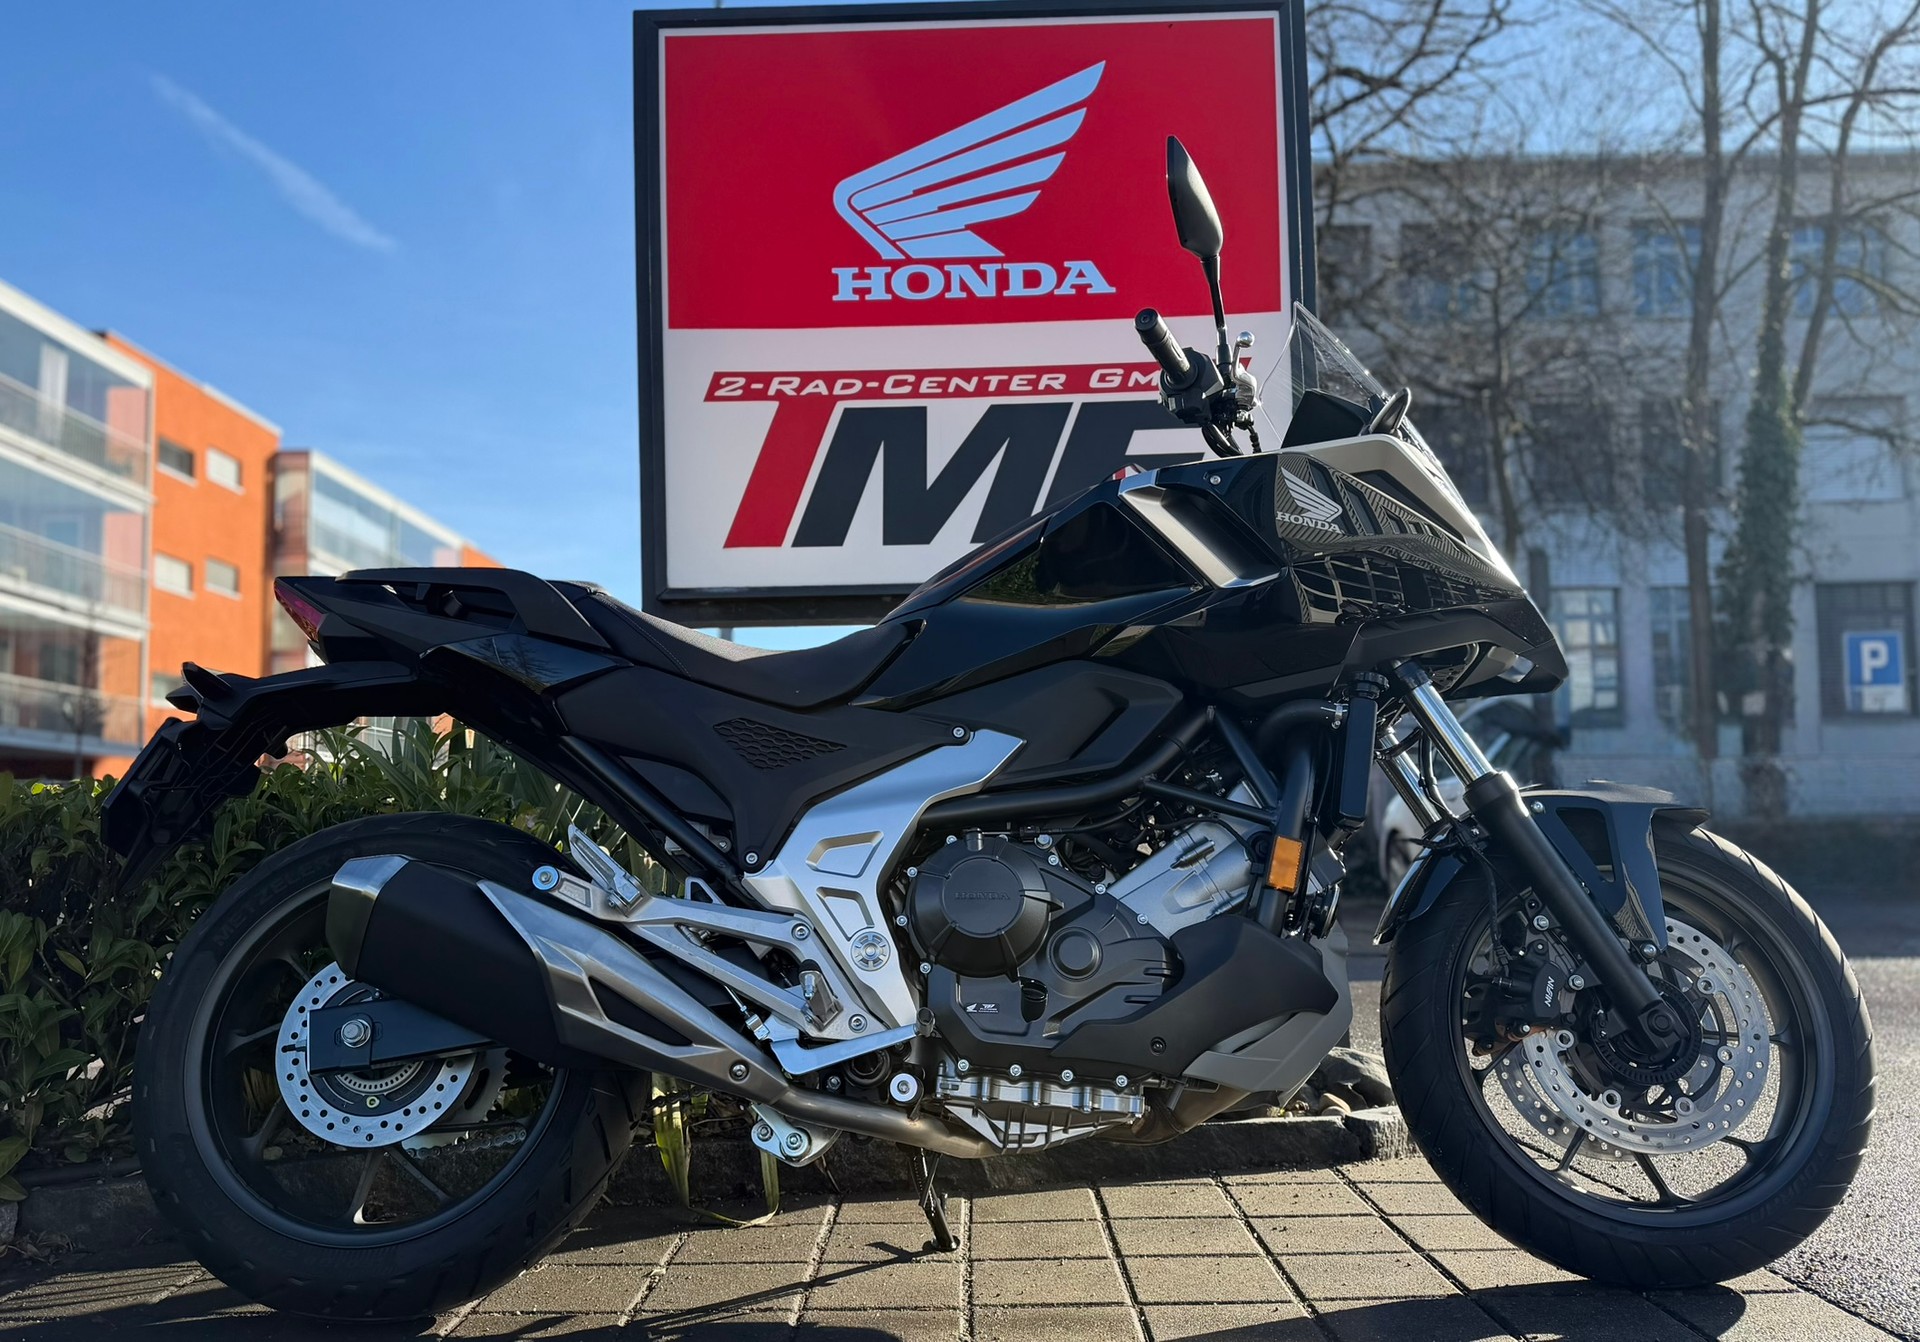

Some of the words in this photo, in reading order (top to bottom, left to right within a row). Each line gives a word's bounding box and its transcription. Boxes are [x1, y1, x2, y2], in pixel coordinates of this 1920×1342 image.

[831, 259, 1116, 302] HONDA
[1276, 511, 1342, 534] HONDA
[1860, 639, 1889, 684] P
